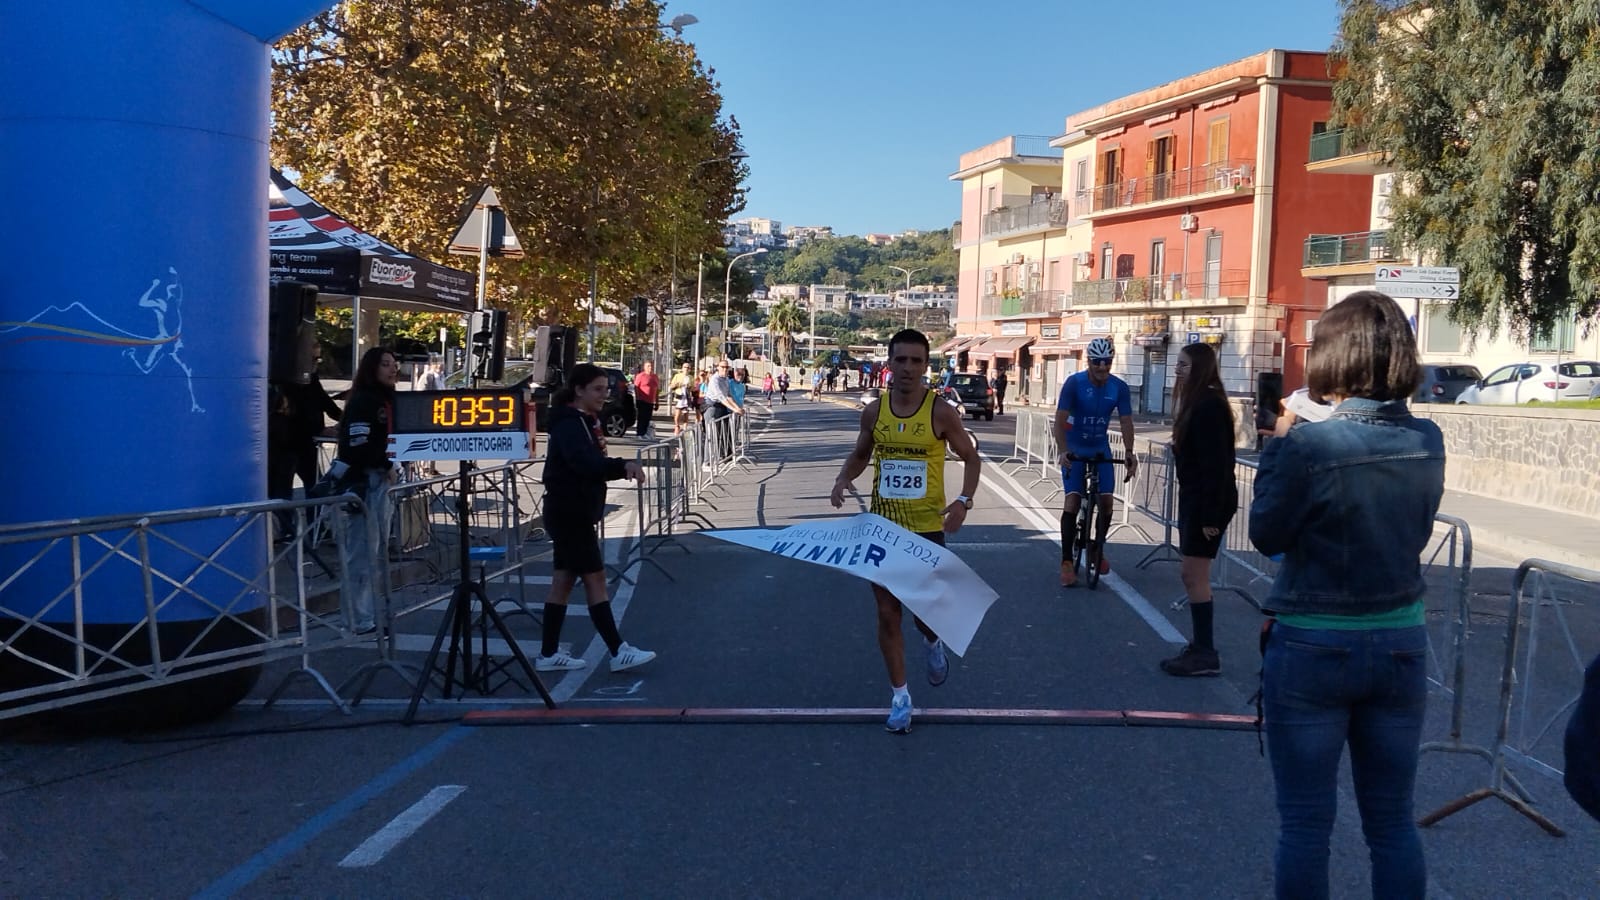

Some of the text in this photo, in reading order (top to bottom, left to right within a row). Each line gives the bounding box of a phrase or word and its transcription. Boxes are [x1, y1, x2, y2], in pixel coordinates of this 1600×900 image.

[289, 253, 317, 263] team
[1190, 335, 1198, 344] P
[1083, 416, 1106, 425] ITA
[431, 436, 513, 453] CRONOMETROGARA
[884, 474, 923, 489] 1528
[770, 541, 887, 568] WINNER
[903, 540, 941, 568] 2024
